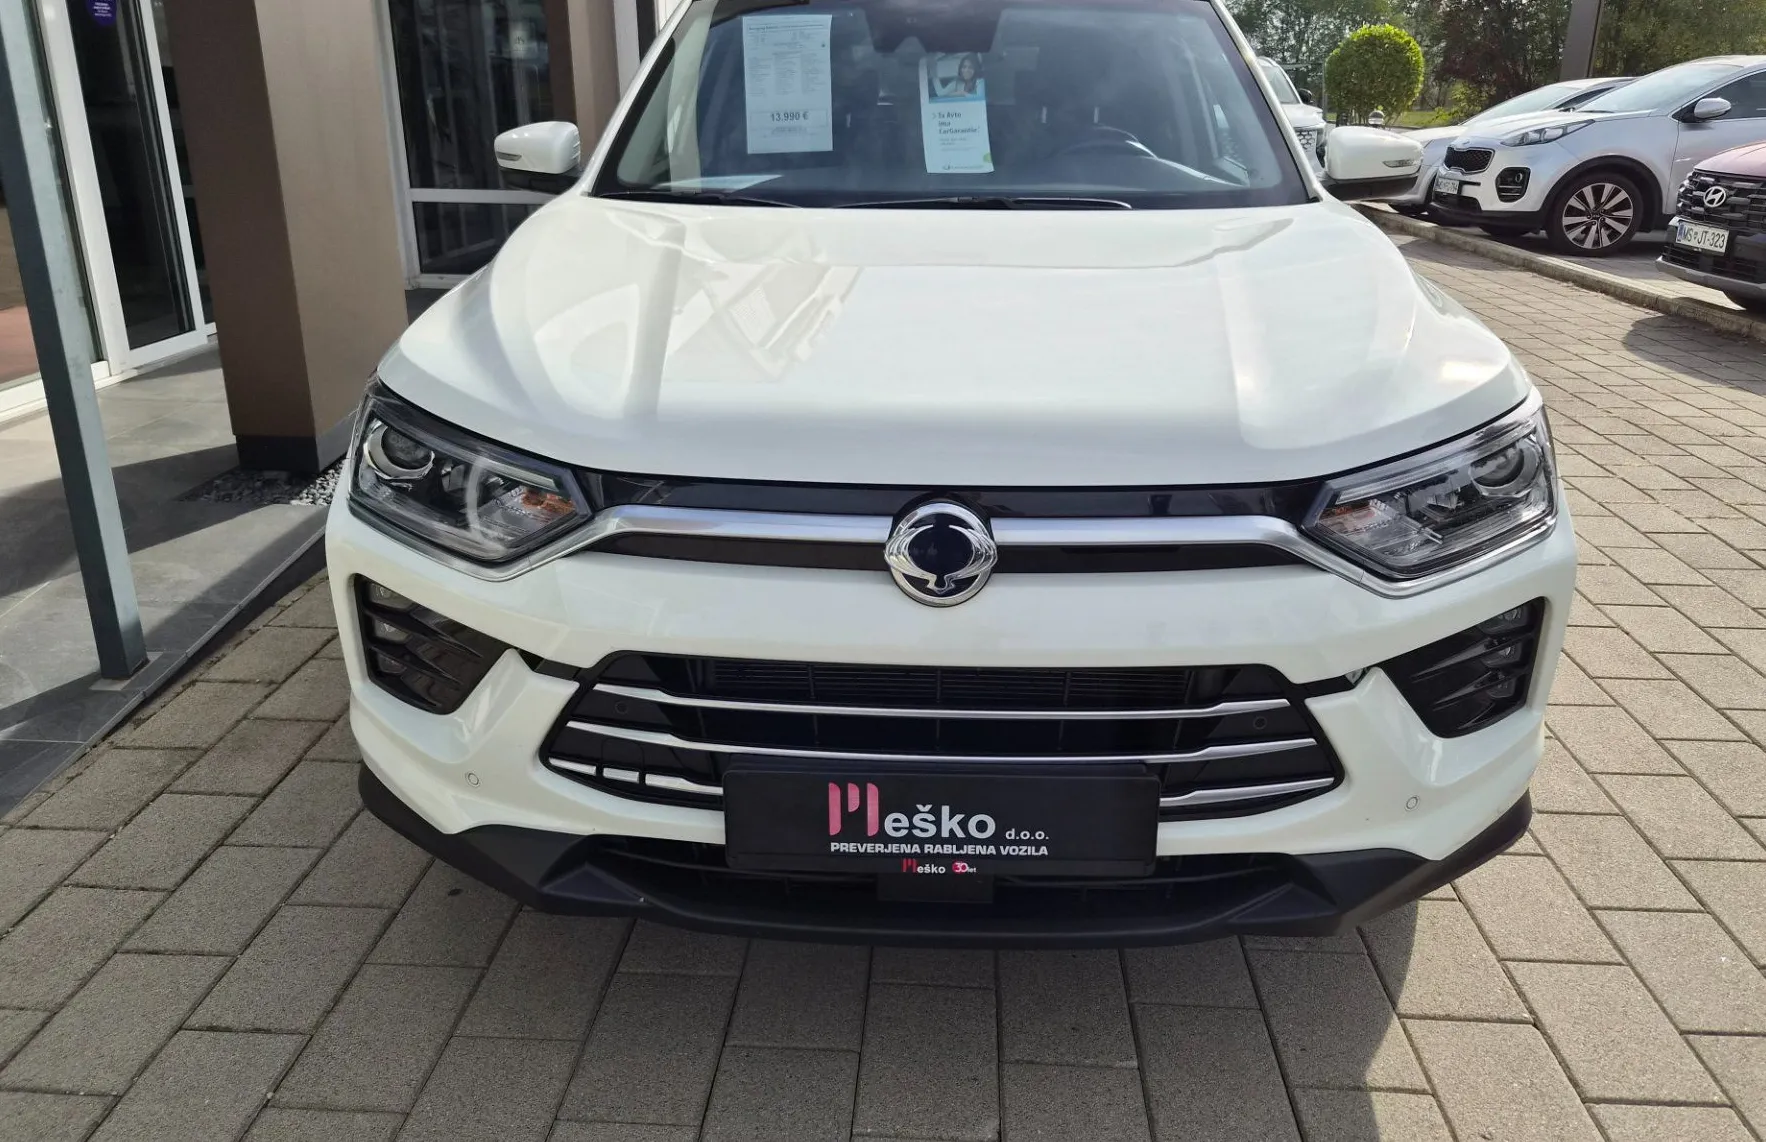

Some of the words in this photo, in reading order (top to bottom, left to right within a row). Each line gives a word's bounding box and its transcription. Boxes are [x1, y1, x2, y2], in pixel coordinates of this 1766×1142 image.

[771, 111, 800, 122] 13.990
[803, 111, 809, 120] €
[1697, 230, 1726, 249] JT-323
[828, 782, 996, 839] Meško
[1005, 828, 1049, 840] d.o.o.
[830, 842, 921, 854] PREVERJENA
[924, 843, 997, 855] RABLJENA
[999, 845, 1048, 856] VOZILA
